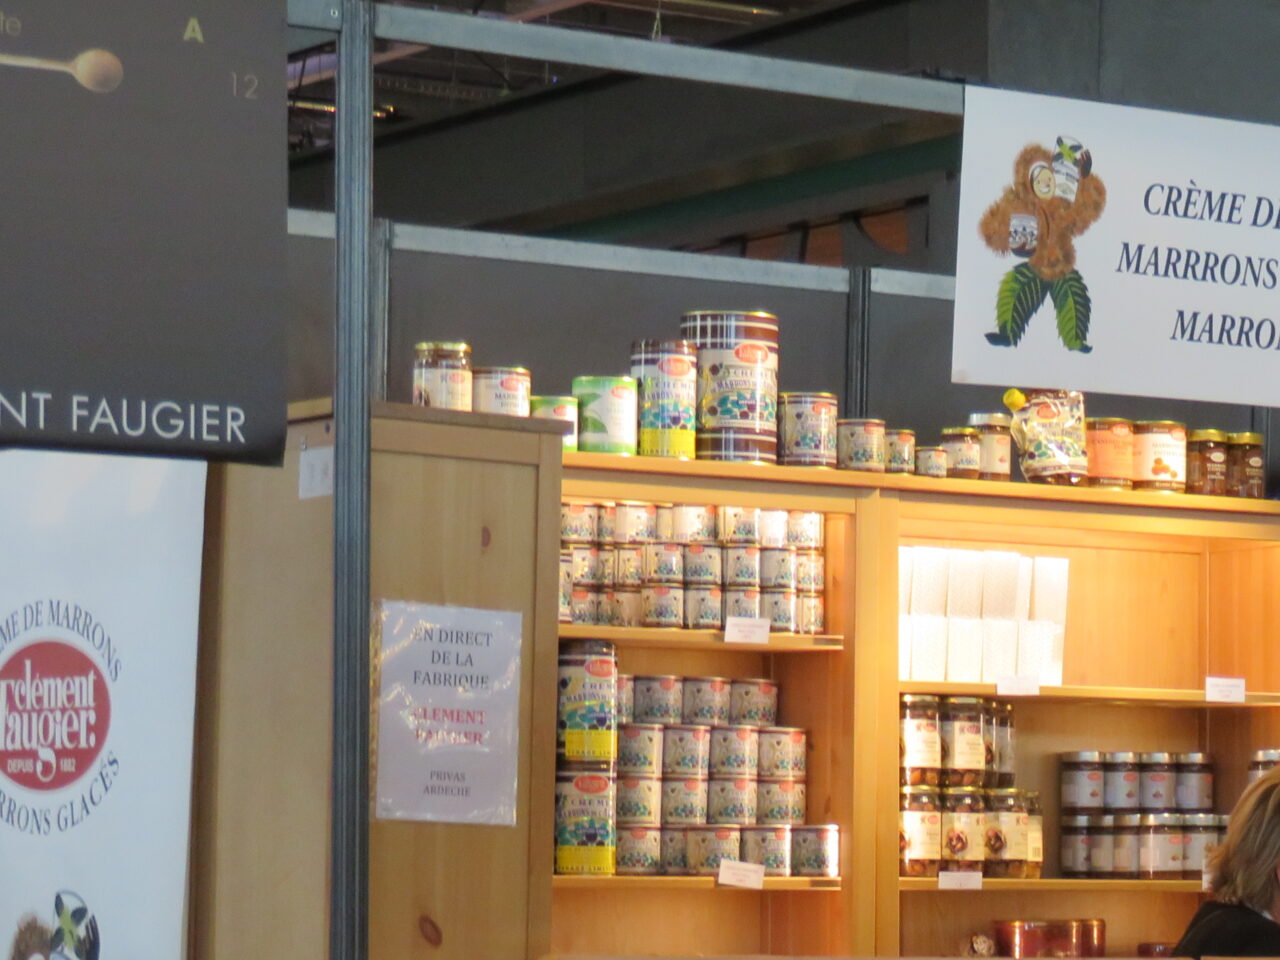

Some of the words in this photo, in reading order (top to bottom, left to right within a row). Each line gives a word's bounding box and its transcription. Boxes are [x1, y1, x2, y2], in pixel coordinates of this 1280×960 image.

[183, 17, 204, 44] A
[231, 71, 259, 99] 12
[1143, 179, 1246, 225] CRÈME
[1116, 241, 1279, 291] MARRRONS
[71, 394, 246, 444] FAUGIER
[23, 600, 43, 632] DE
[49, 598, 123, 683] MARRONS
[438, 629, 493, 648] DIRECT
[431, 650, 451, 666] DE
[455, 652, 474, 667] LA
[413, 670, 489, 693] FABRIQUE
[7, 758, 34, 774] DEPUIS
[430, 770, 466, 782] PRIVAS
[56, 749, 120, 834] GLACÉS
